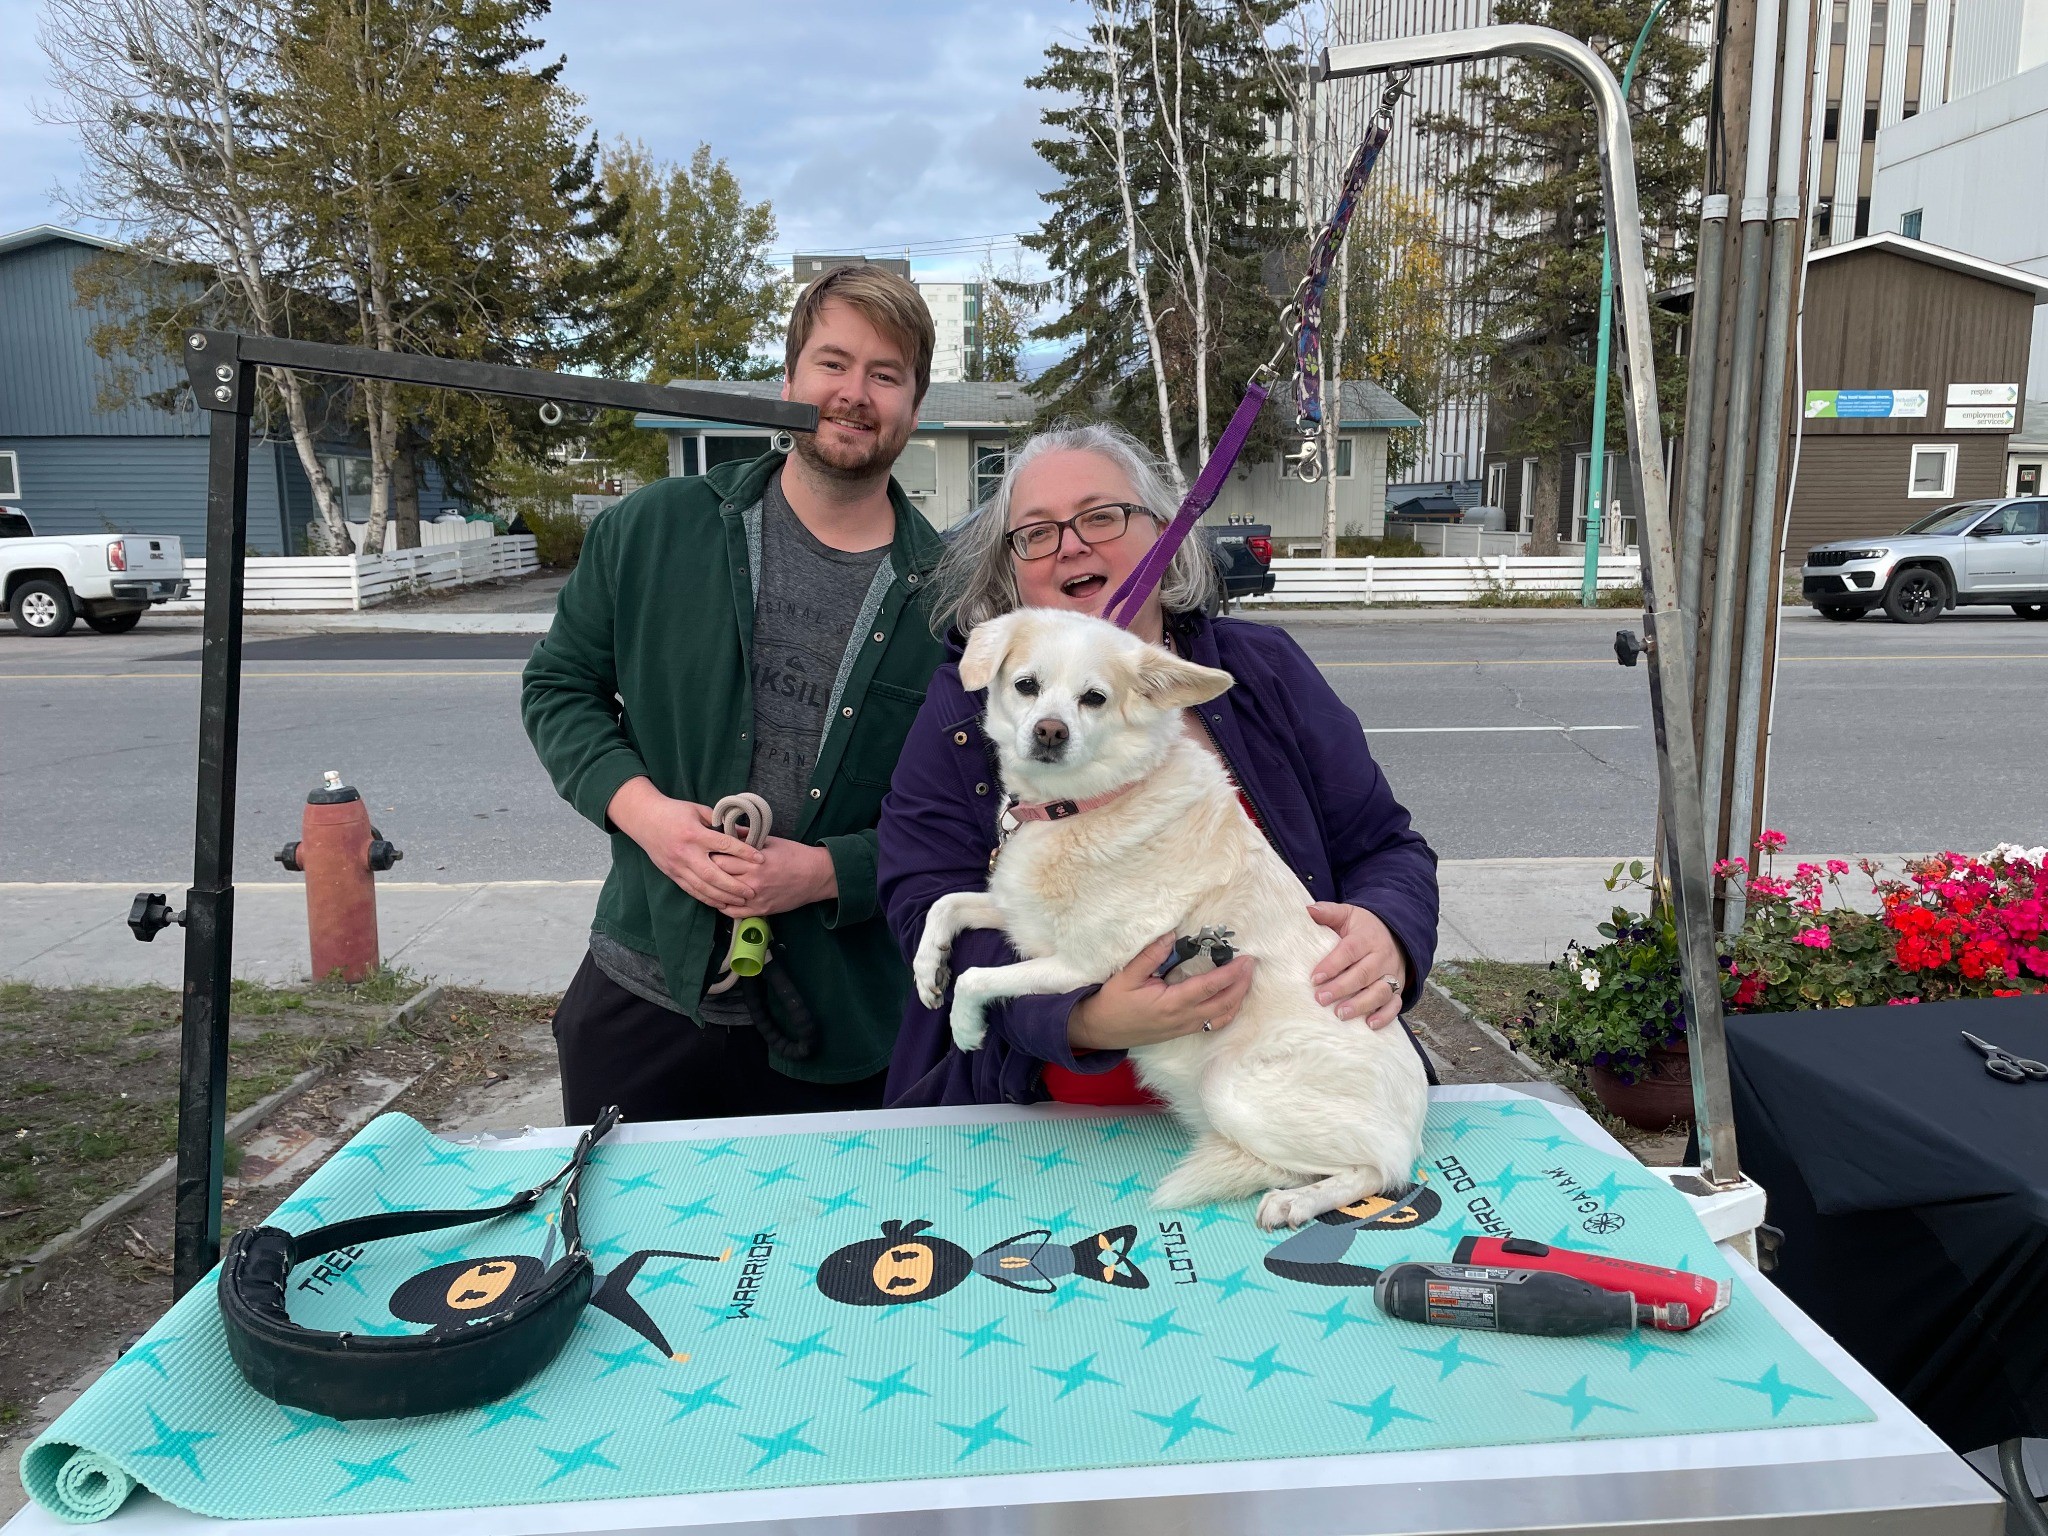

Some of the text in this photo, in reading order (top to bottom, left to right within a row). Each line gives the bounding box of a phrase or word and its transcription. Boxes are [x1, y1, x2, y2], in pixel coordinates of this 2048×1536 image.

[1962, 411, 2004, 420] employment
[1970, 388, 1993, 396] respite
[297, 1246, 365, 1296] TREE
[726, 1232, 777, 1320] WARRIOR
[1158, 1221, 1198, 1285] LOTUS
